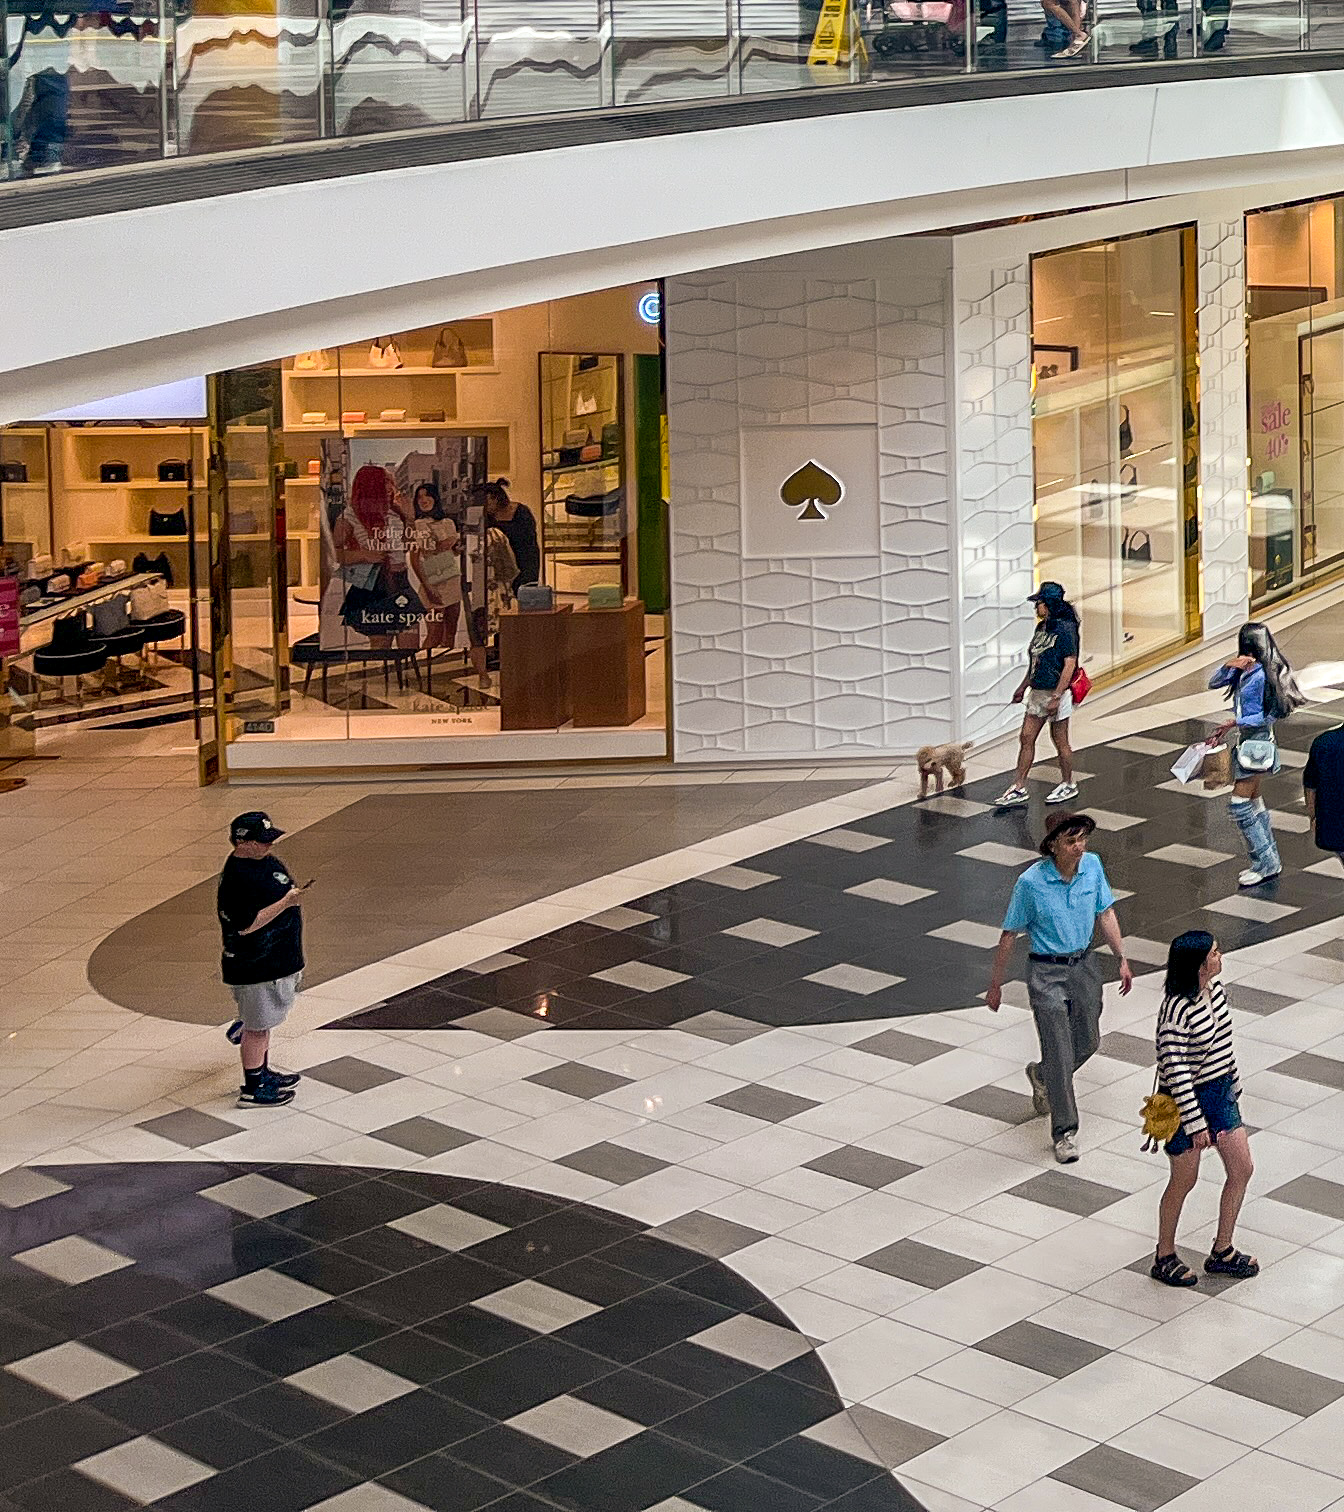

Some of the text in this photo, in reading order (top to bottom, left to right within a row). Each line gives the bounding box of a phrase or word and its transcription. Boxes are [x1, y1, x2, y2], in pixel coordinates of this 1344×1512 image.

[1261, 402, 1291, 434] sale
[372, 527, 432, 540] To the Ones
[366, 539, 437, 552] Who Carry Us
[361, 609, 444, 627] kate spade
